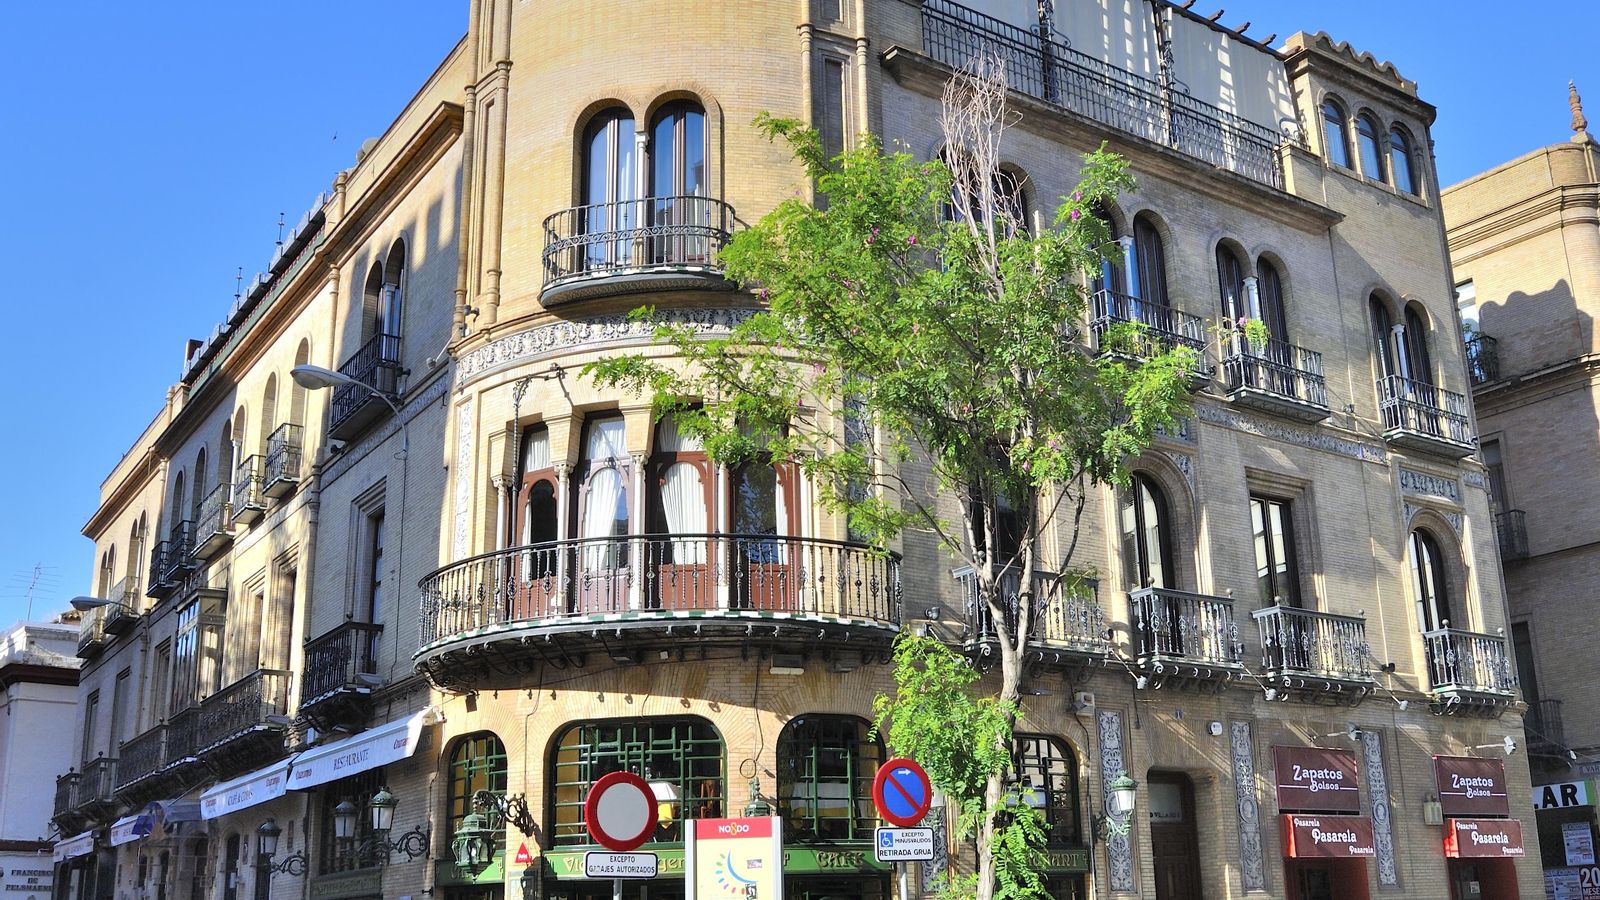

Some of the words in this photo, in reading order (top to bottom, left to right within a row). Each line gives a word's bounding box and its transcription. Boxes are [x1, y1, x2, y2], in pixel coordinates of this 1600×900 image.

[333, 748, 369, 771] RESTAURANTE
[1292, 764, 1343, 783] Zapatos
[1309, 780, 1340, 792] Bolsos
[1451, 773, 1494, 789] Zapatos
[1466, 787, 1491, 799] Bolsos
[1293, 818, 1320, 828] Pasarela
[1456, 821, 1478, 831] Pasarela
[1312, 828, 1357, 845] Pasarela
[1471, 830, 1509, 846] Pasarela
[879, 849, 912, 857] RETIRADA
[913, 848, 932, 856] GRUA
[1349, 845, 1374, 855] Pasarela
[1502, 846, 1523, 855] Pasarela
[609, 855, 636, 863] EXCEPTO
[616, 865, 655, 874] AUTORIZADOS
